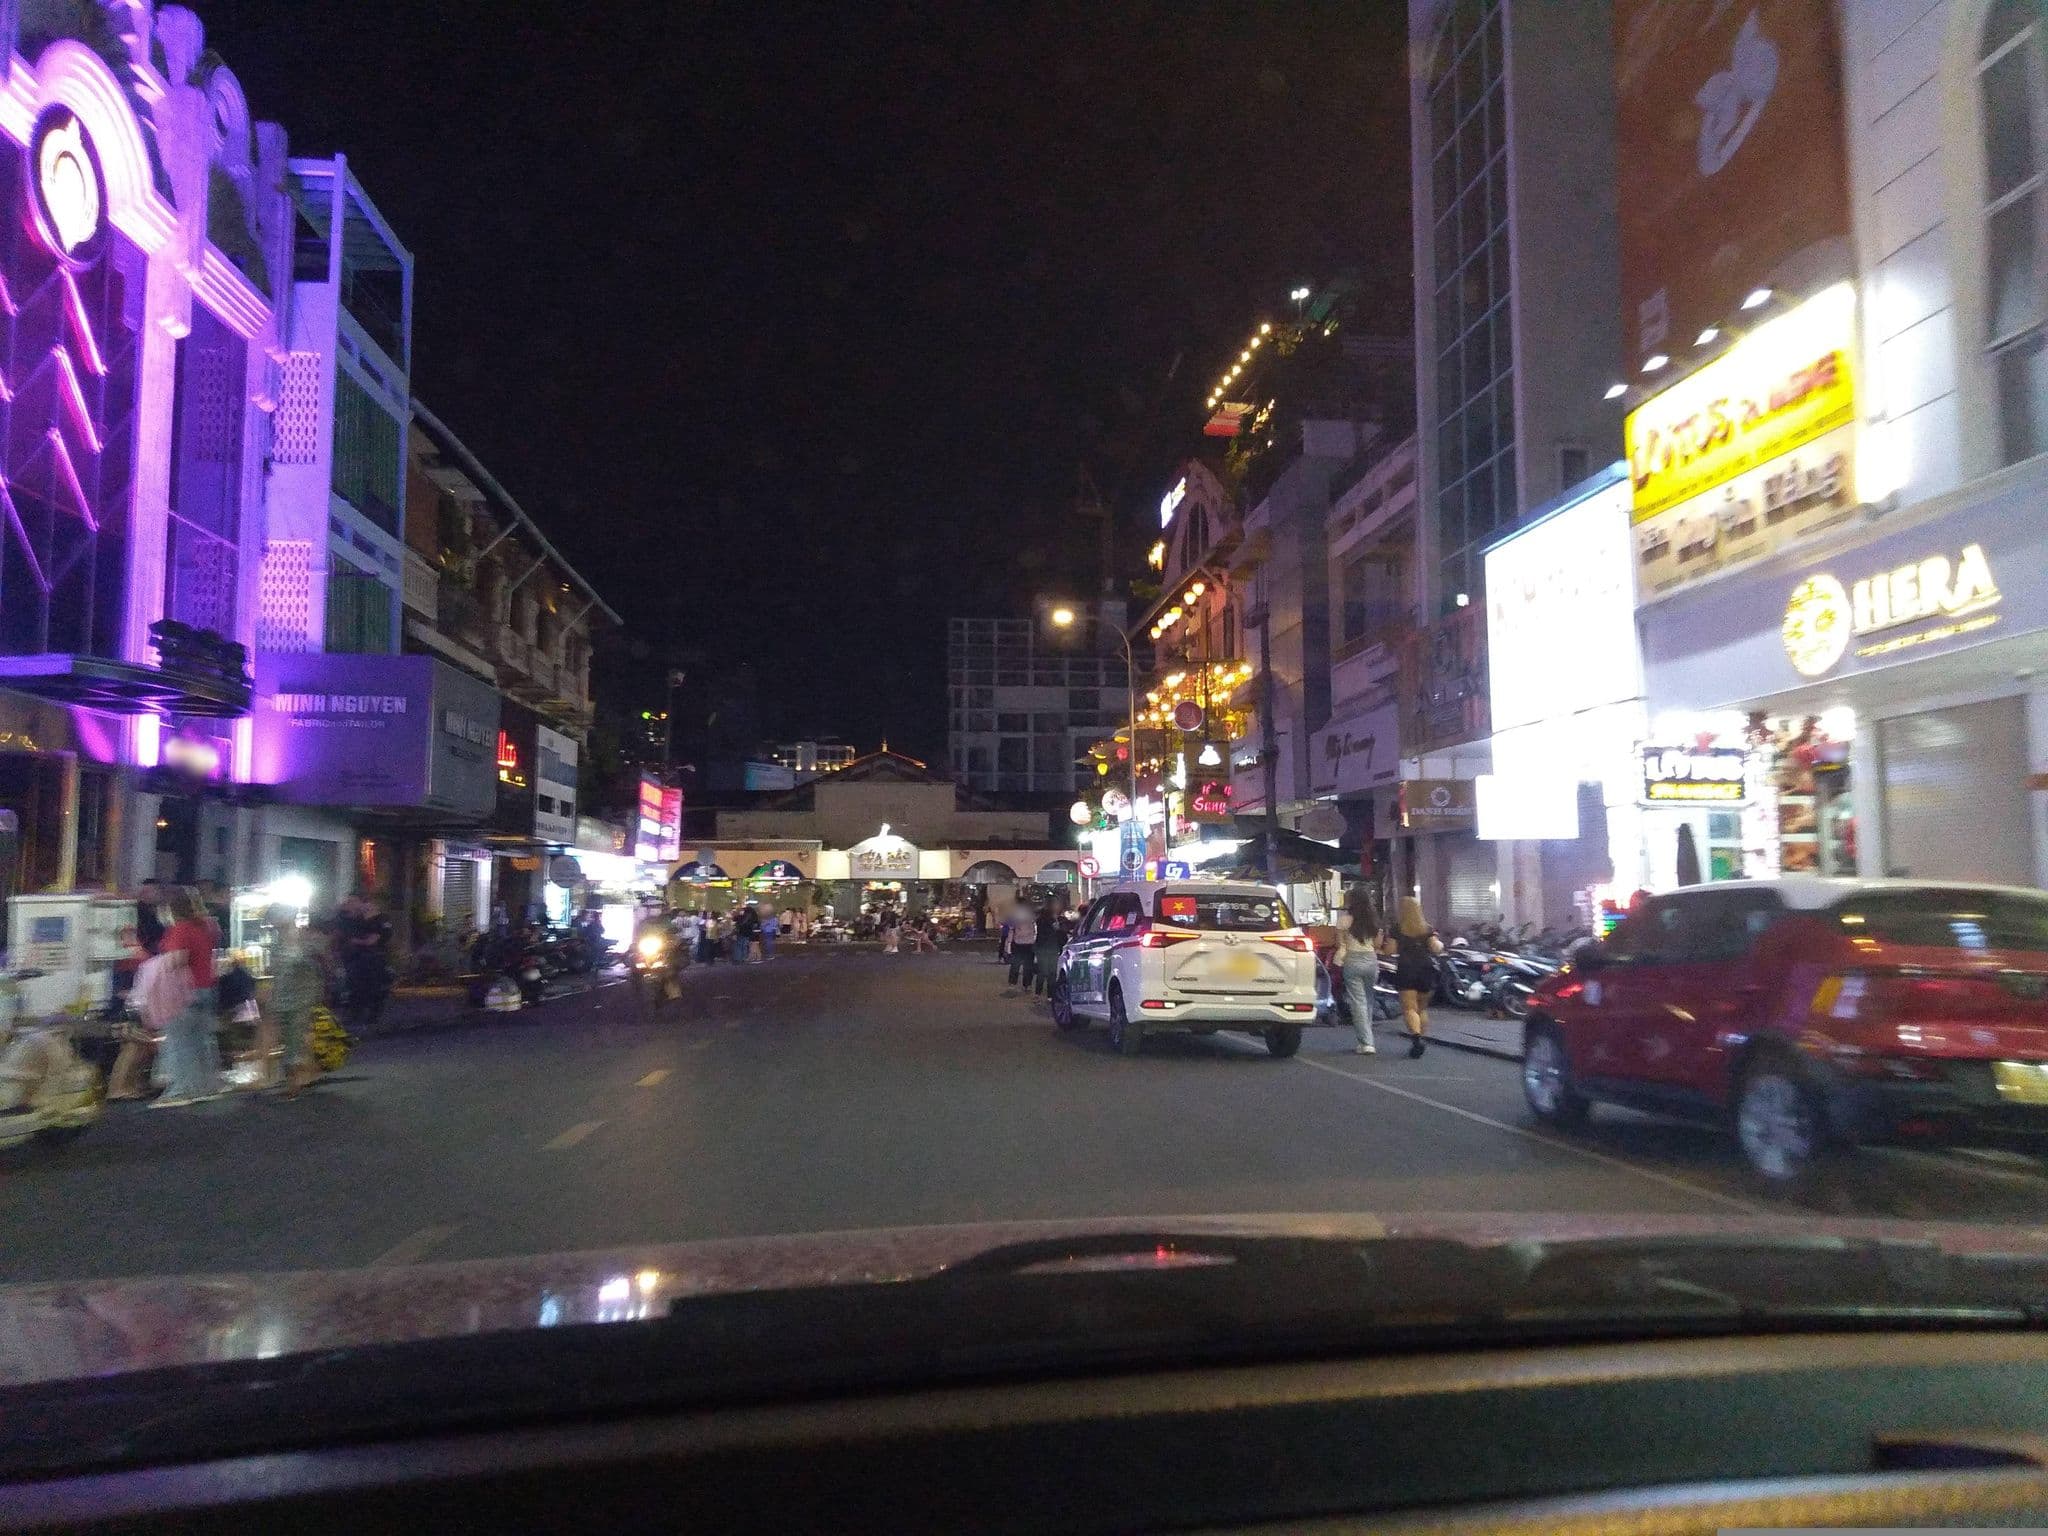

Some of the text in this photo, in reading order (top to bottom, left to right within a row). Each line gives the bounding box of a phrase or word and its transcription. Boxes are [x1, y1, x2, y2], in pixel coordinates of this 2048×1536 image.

[1852, 544, 2001, 635] HERA
[273, 693, 407, 713] MINH NGUYEN
